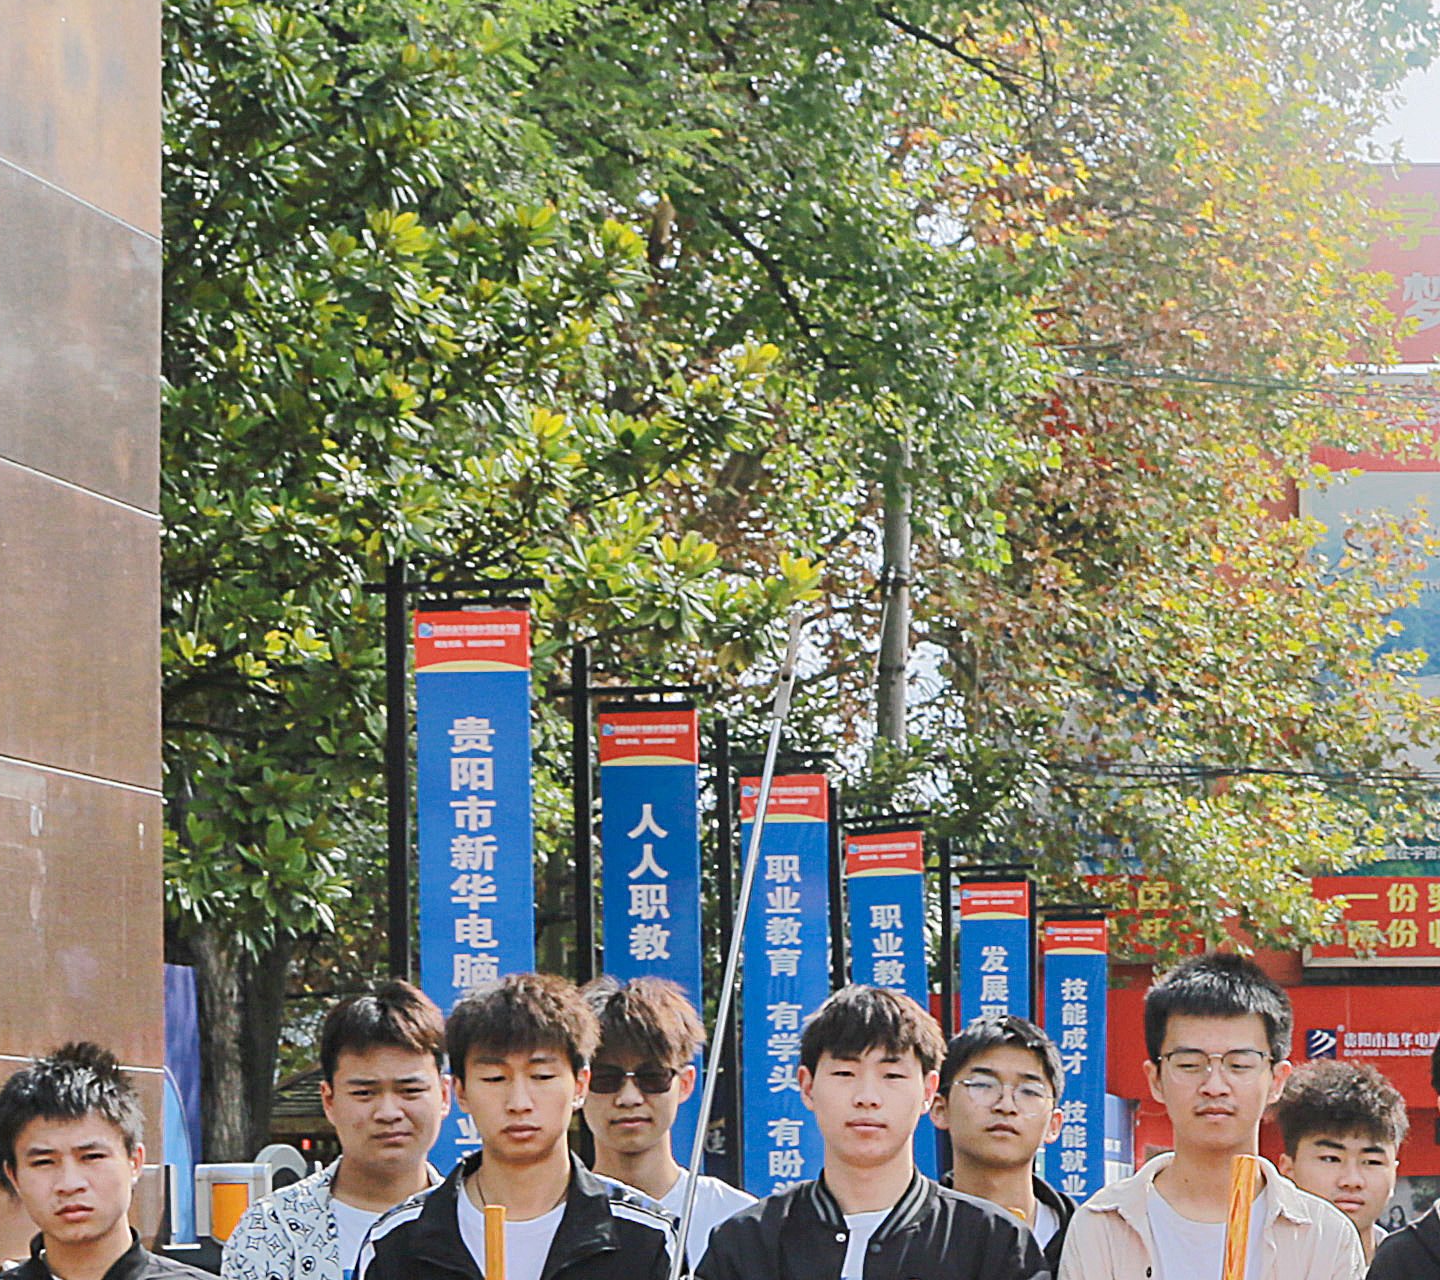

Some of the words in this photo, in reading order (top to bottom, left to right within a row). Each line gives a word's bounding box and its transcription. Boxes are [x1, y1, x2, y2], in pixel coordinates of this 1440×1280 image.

[626, 802, 671, 962] 人人职教
[763, 854, 803, 978] 职业教育
[868, 904, 907, 994] 职业教
[1060, 977, 1089, 1075] 技能成才
[1060, 1100, 1089, 1197] 技能就业
